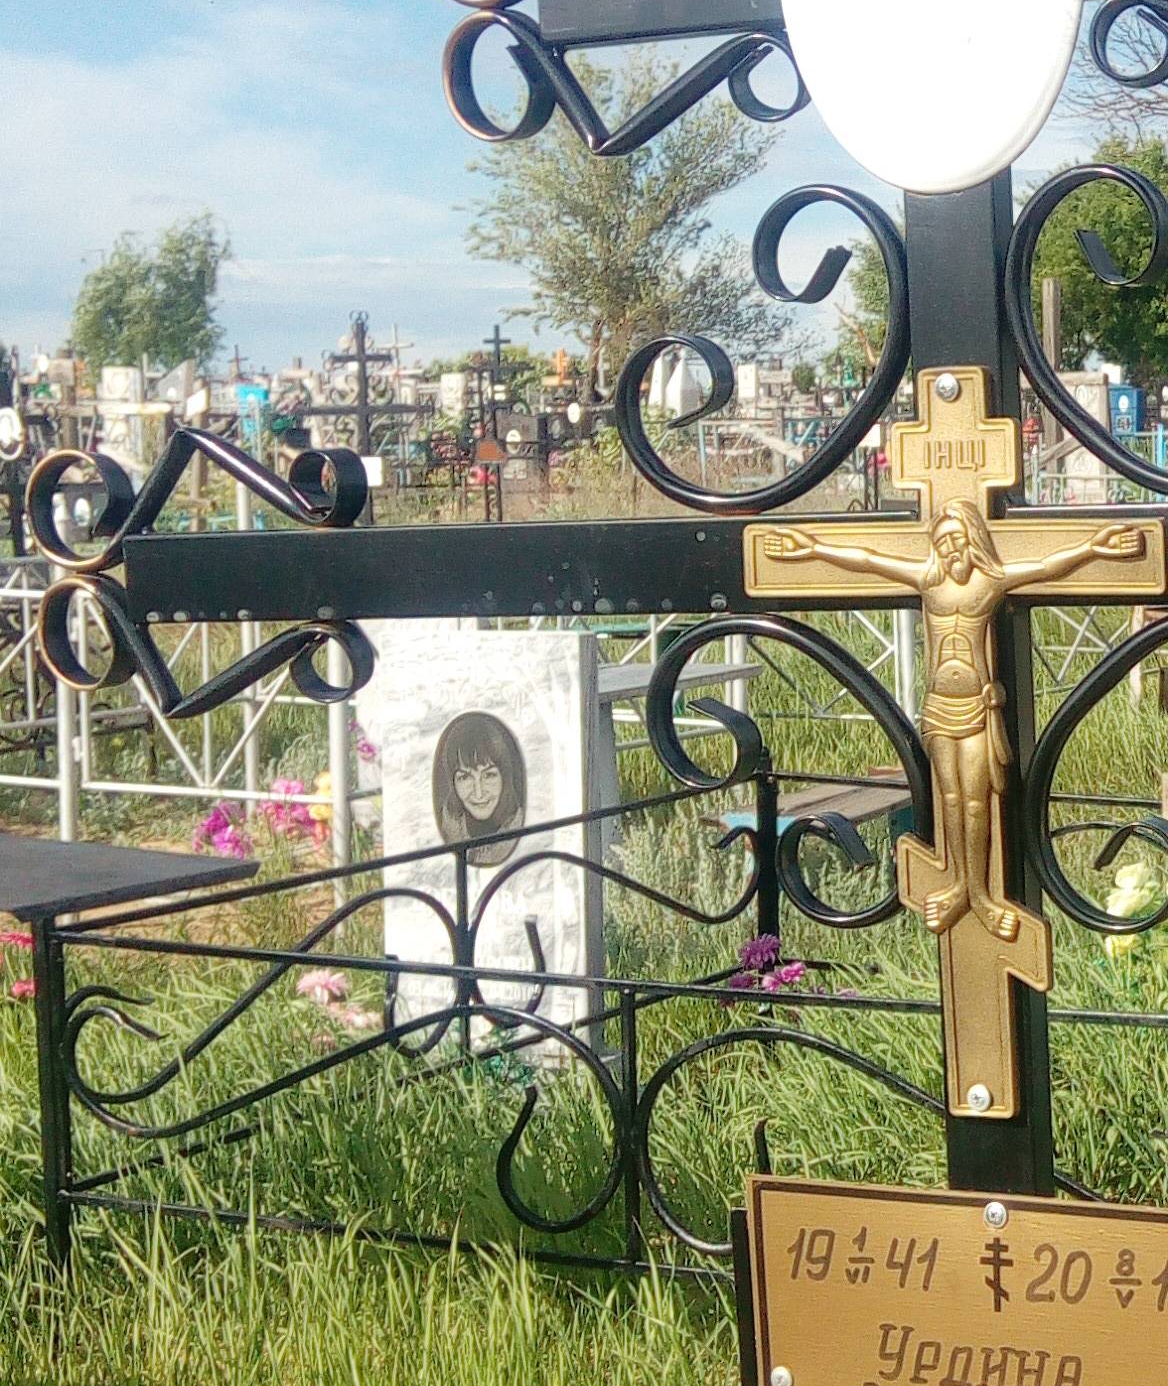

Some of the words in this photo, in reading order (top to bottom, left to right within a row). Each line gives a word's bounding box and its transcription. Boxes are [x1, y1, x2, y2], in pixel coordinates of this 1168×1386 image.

[786, 1226, 836, 1282] 19
[885, 1236, 940, 1292] 41
[1024, 1241, 1093, 1305] 20
